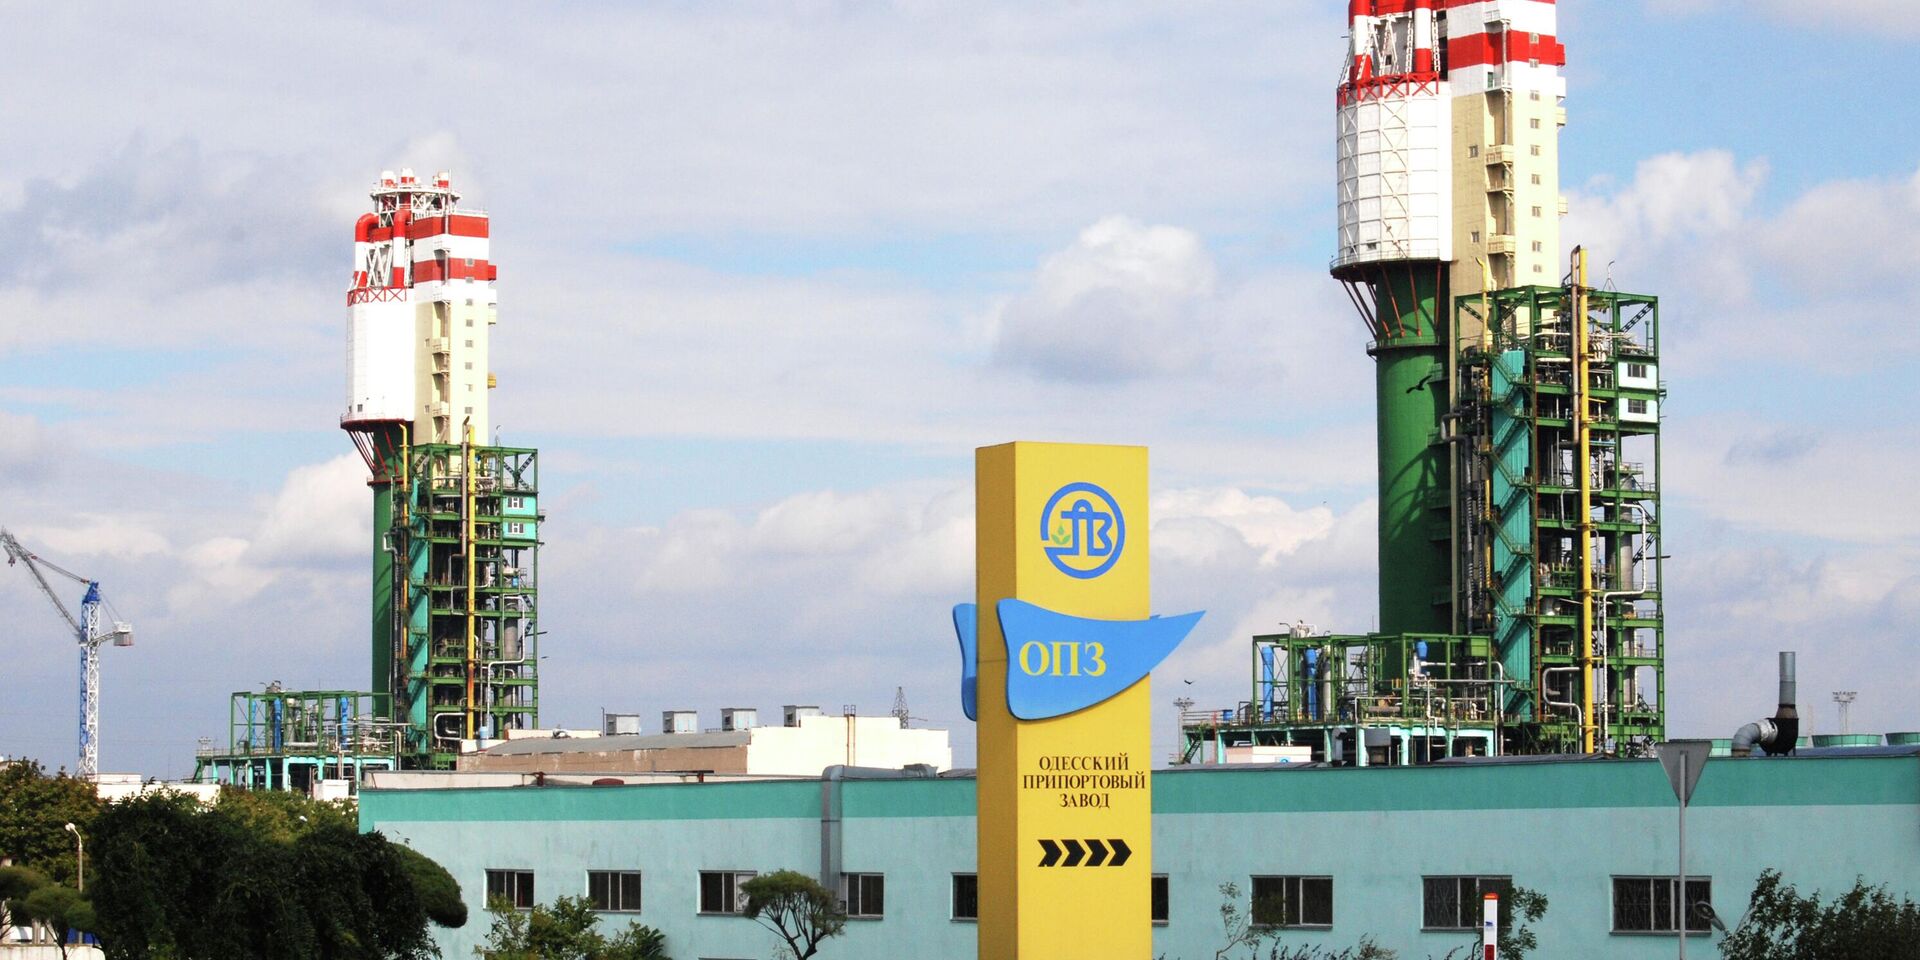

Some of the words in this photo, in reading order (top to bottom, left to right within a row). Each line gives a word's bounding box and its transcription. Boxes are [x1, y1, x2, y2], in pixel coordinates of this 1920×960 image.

[1019, 640, 1107, 677] ОПЗ
[1038, 752, 1129, 771] ОДЕССКИЙ
[1022, 771, 1146, 789] ПРИПОРТОВЫЙ
[1059, 792, 1110, 809] ЗАВОД
